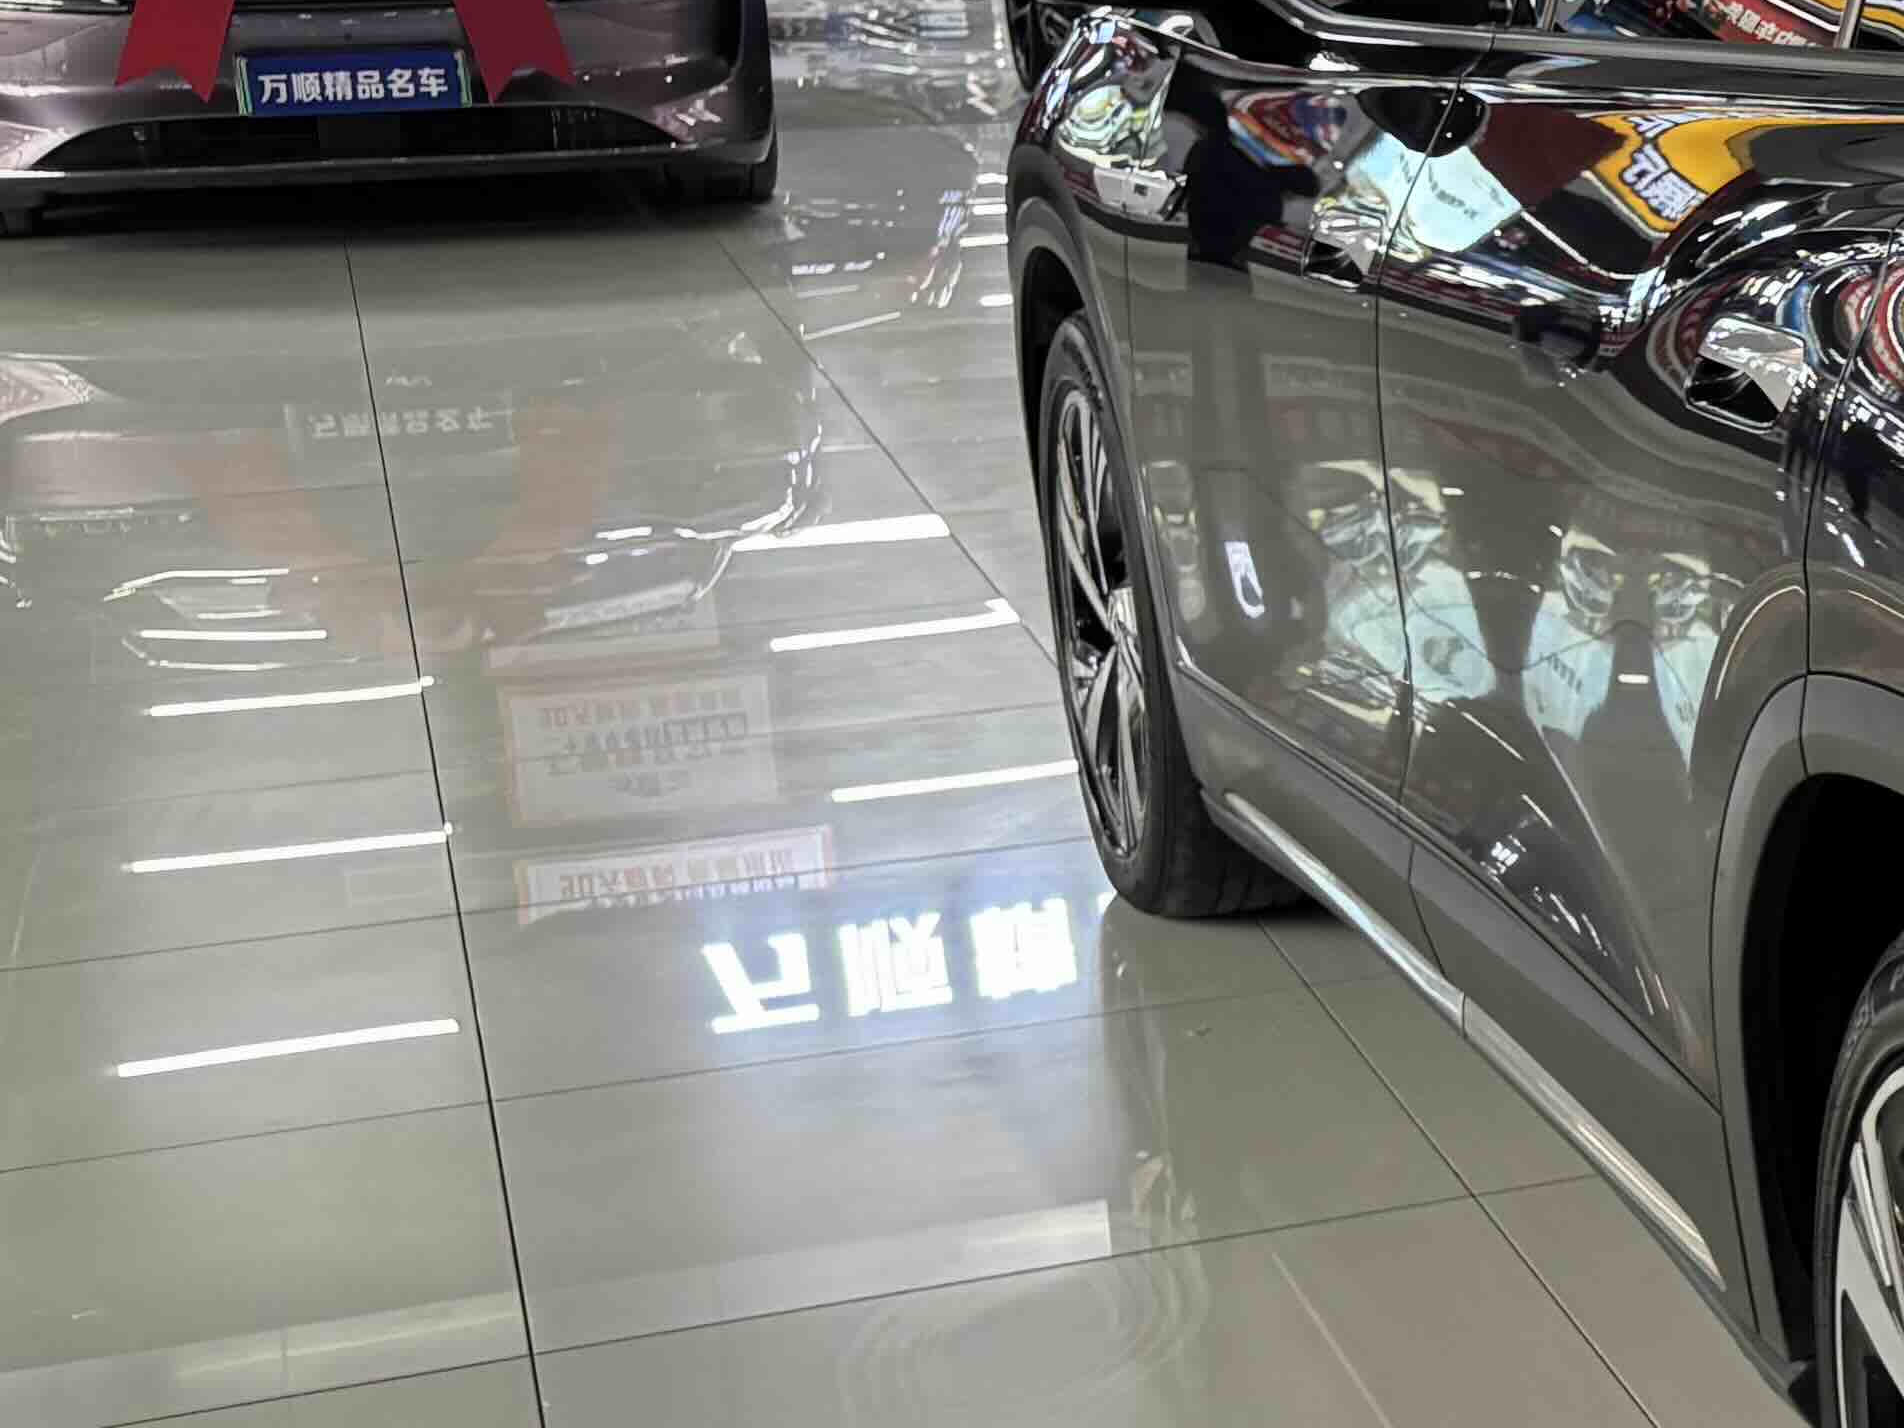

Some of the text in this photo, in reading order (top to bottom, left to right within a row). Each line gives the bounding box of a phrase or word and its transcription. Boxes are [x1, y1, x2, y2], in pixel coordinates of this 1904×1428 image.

[257, 67, 449, 104] 万顺精品名车
